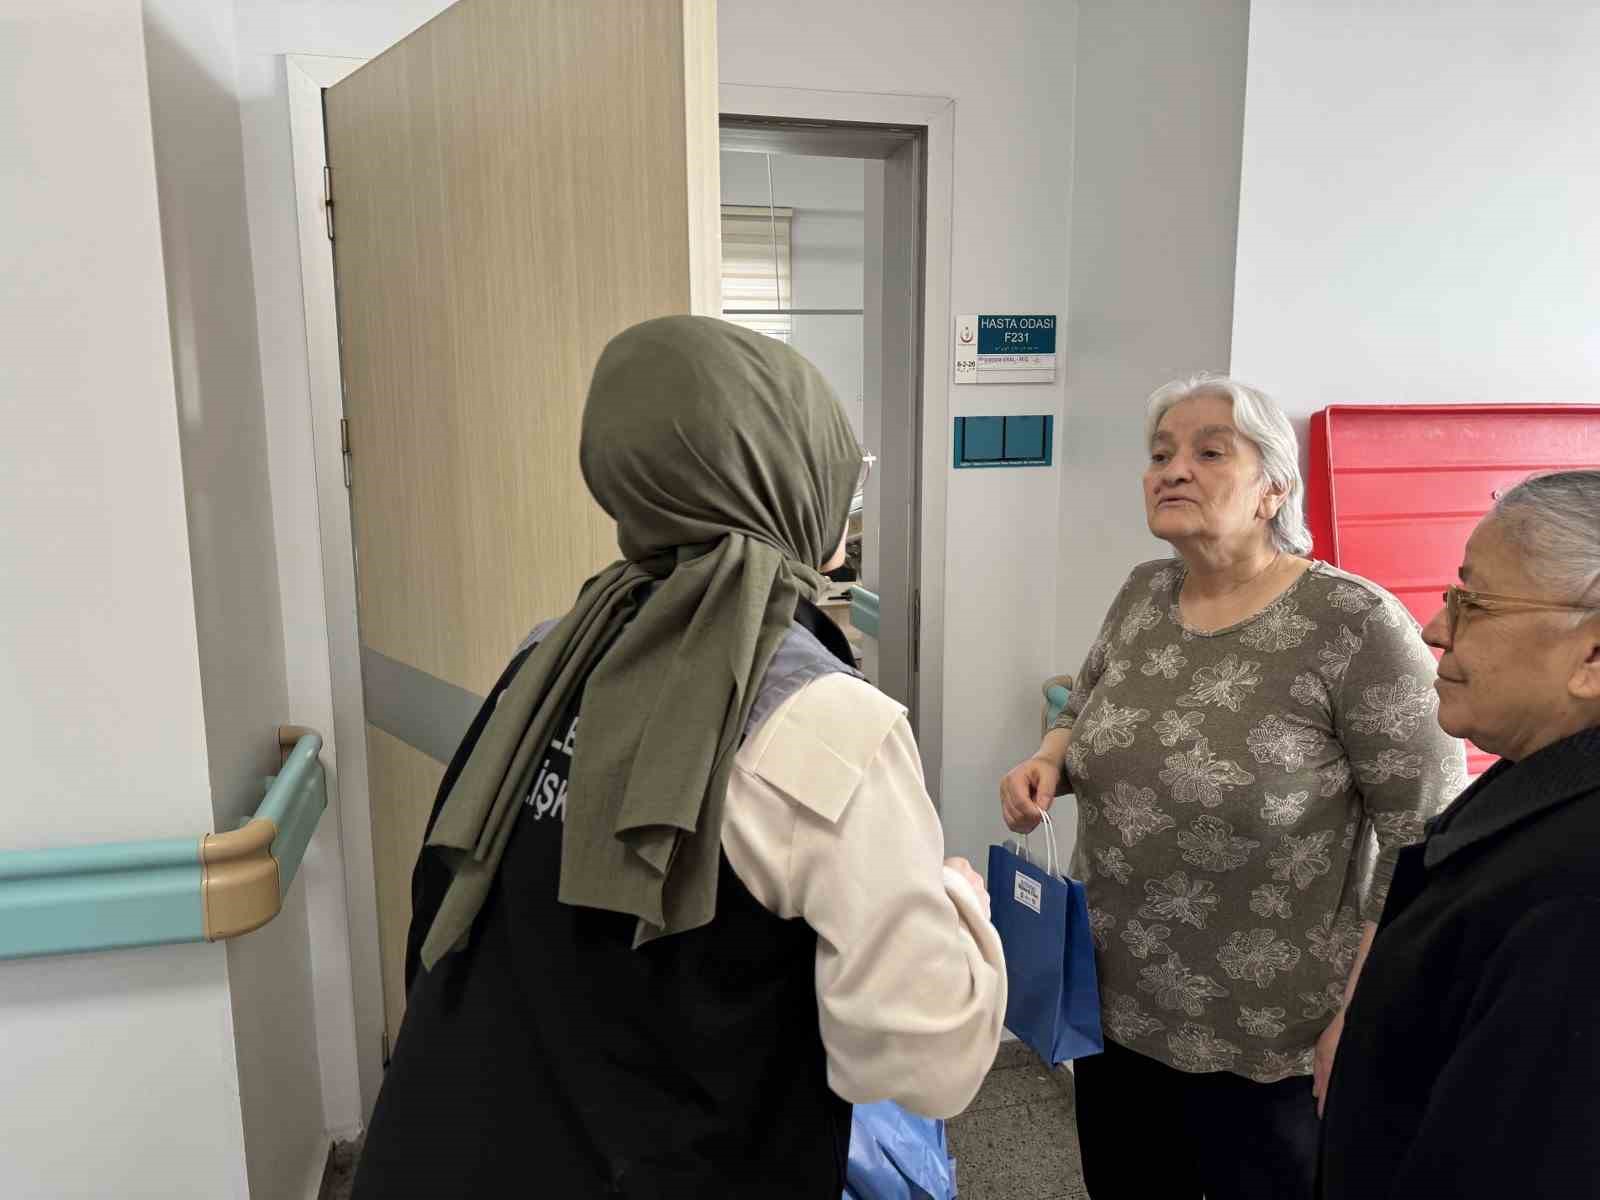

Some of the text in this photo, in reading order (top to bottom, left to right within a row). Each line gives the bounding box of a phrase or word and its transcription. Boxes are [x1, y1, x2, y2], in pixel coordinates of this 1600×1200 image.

[981, 318, 1054, 329] HASTA ODASI
[1004, 332, 1030, 343] F231
